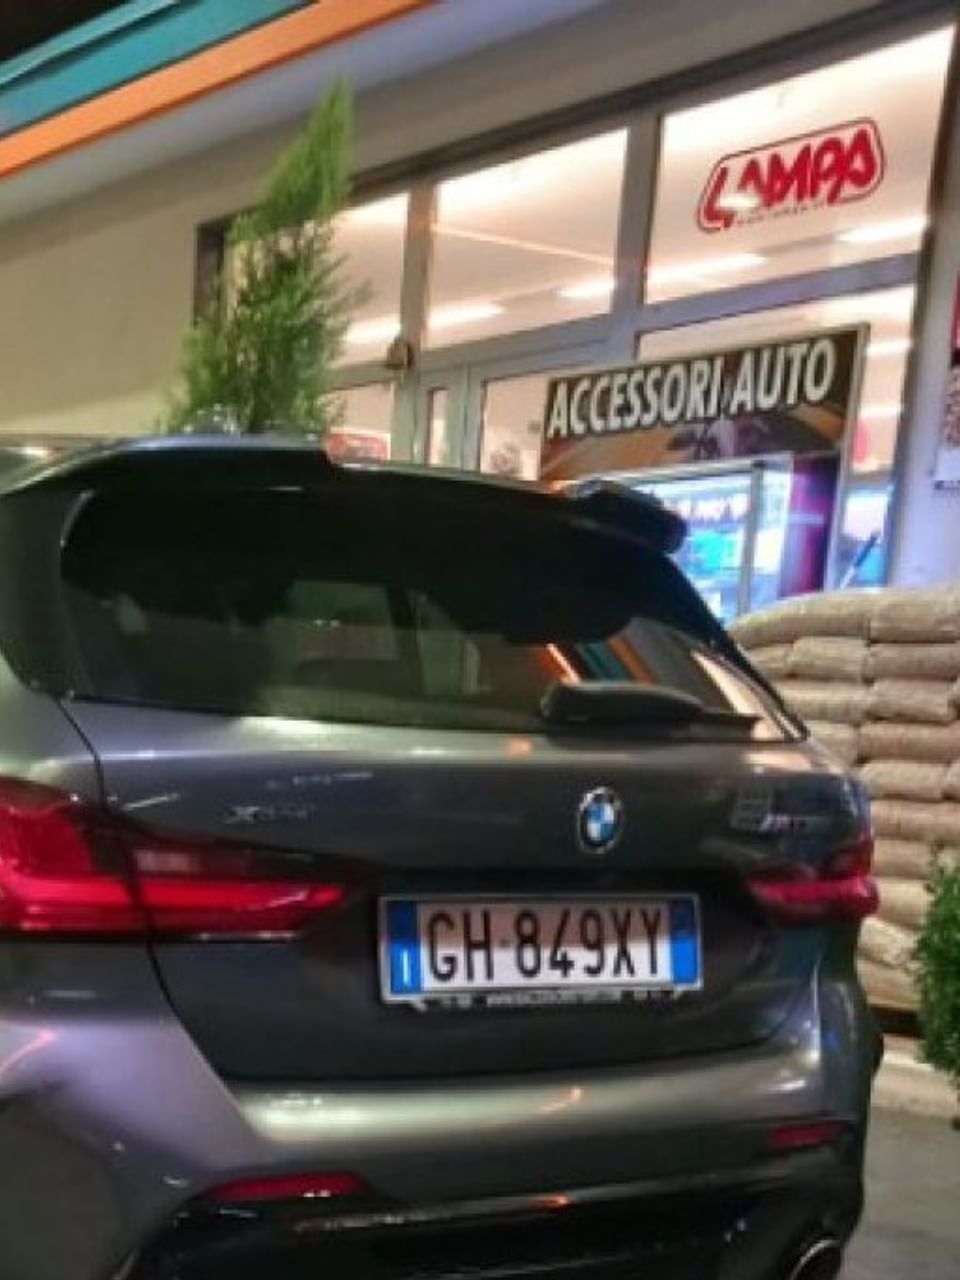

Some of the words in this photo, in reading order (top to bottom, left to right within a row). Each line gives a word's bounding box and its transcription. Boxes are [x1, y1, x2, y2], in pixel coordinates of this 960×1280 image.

[703, 129, 877, 229] LAMPA
[546, 355, 726, 438] ACCESSORI
[728, 338, 837, 413] AUTO
[428, 910, 494, 982] GH
[513, 908, 662, 978] 849XY
